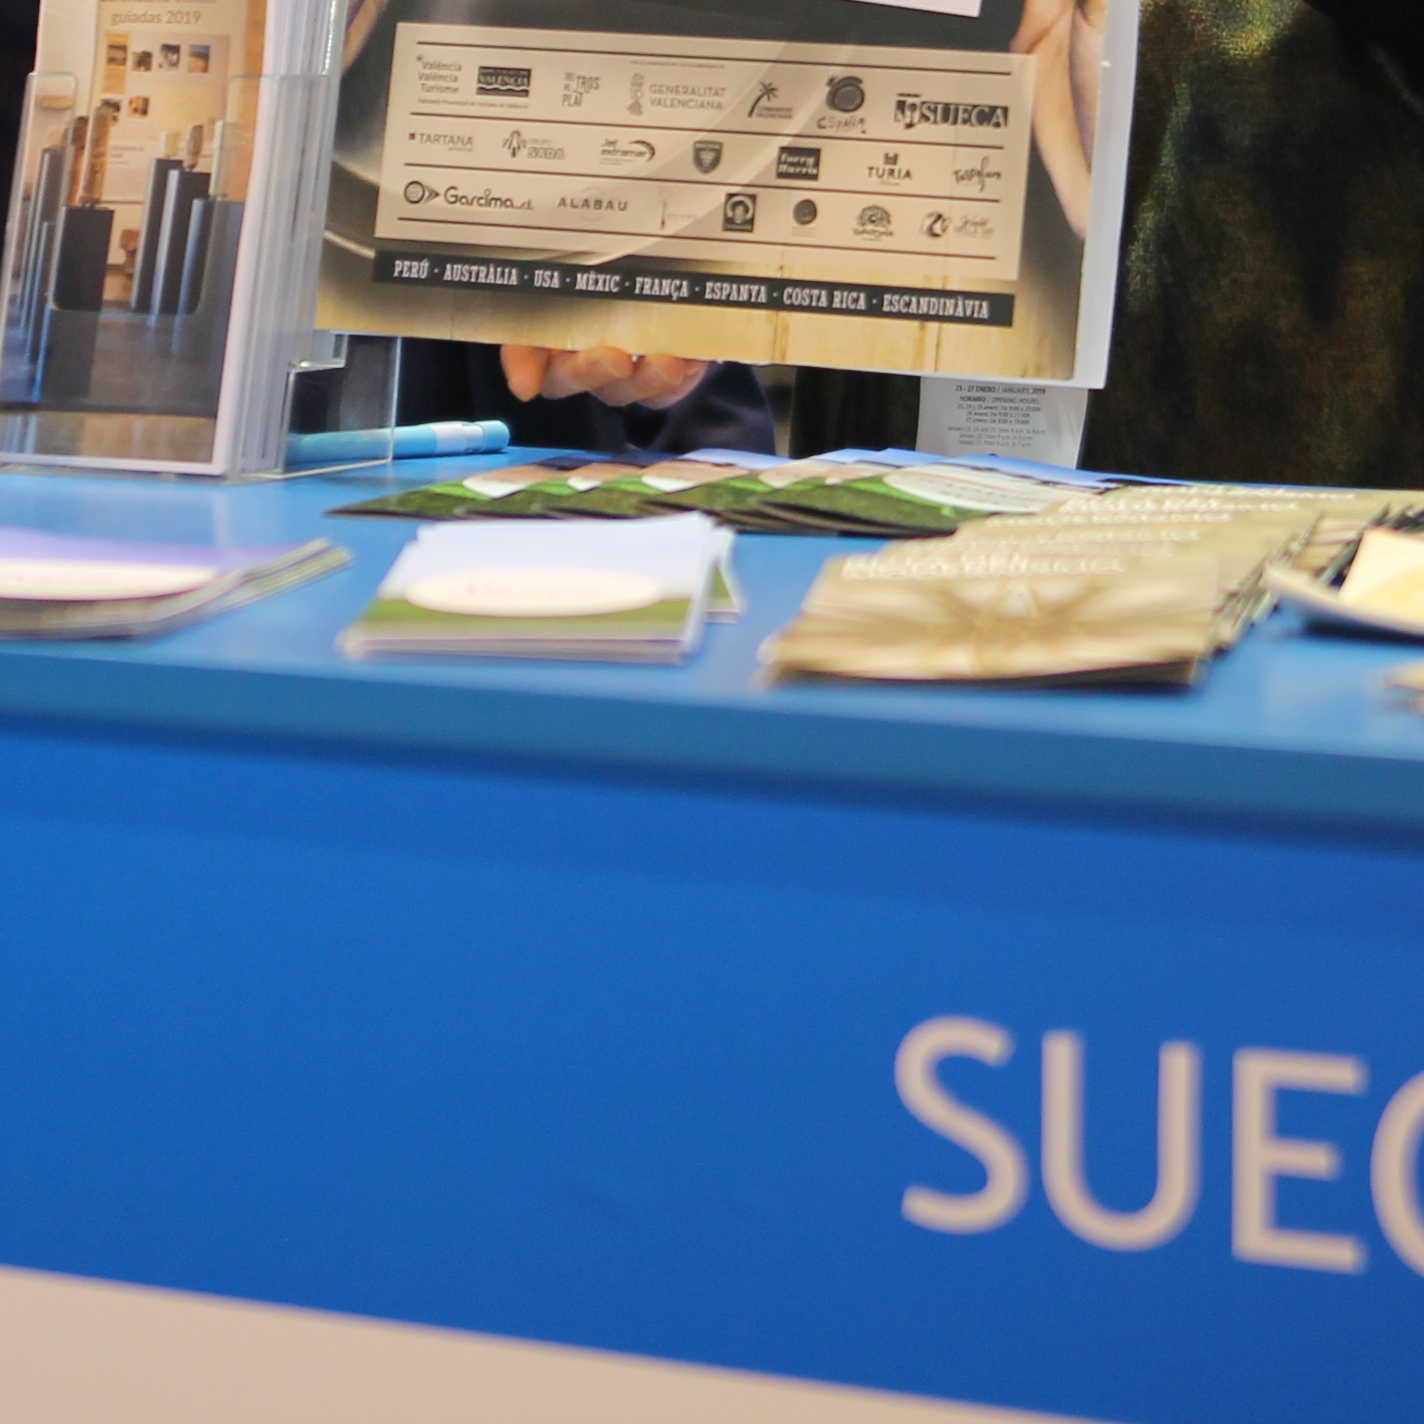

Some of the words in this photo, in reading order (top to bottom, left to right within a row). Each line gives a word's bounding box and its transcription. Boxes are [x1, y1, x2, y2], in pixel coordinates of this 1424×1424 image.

[166, 9, 202, 25] 2019
[649, 84, 727, 98] GENERALITAT
[649, 97, 723, 111] VALENCIANA
[920, 103, 1008, 128] SUECA
[419, 132, 473, 148] TARTANA
[867, 166, 912, 181] TURIA
[557, 197, 628, 212] ALABAU
[393, 259, 428, 278] PERÚ
[533, 269, 560, 288] USA
[634, 275, 689, 300] FRANÇA
[704, 281, 767, 304] ESPANYA
[783, 287, 827, 308] COSTA
[832, 291, 866, 311] RICA
[882, 293, 990, 319] ESCANDINÀVIA
